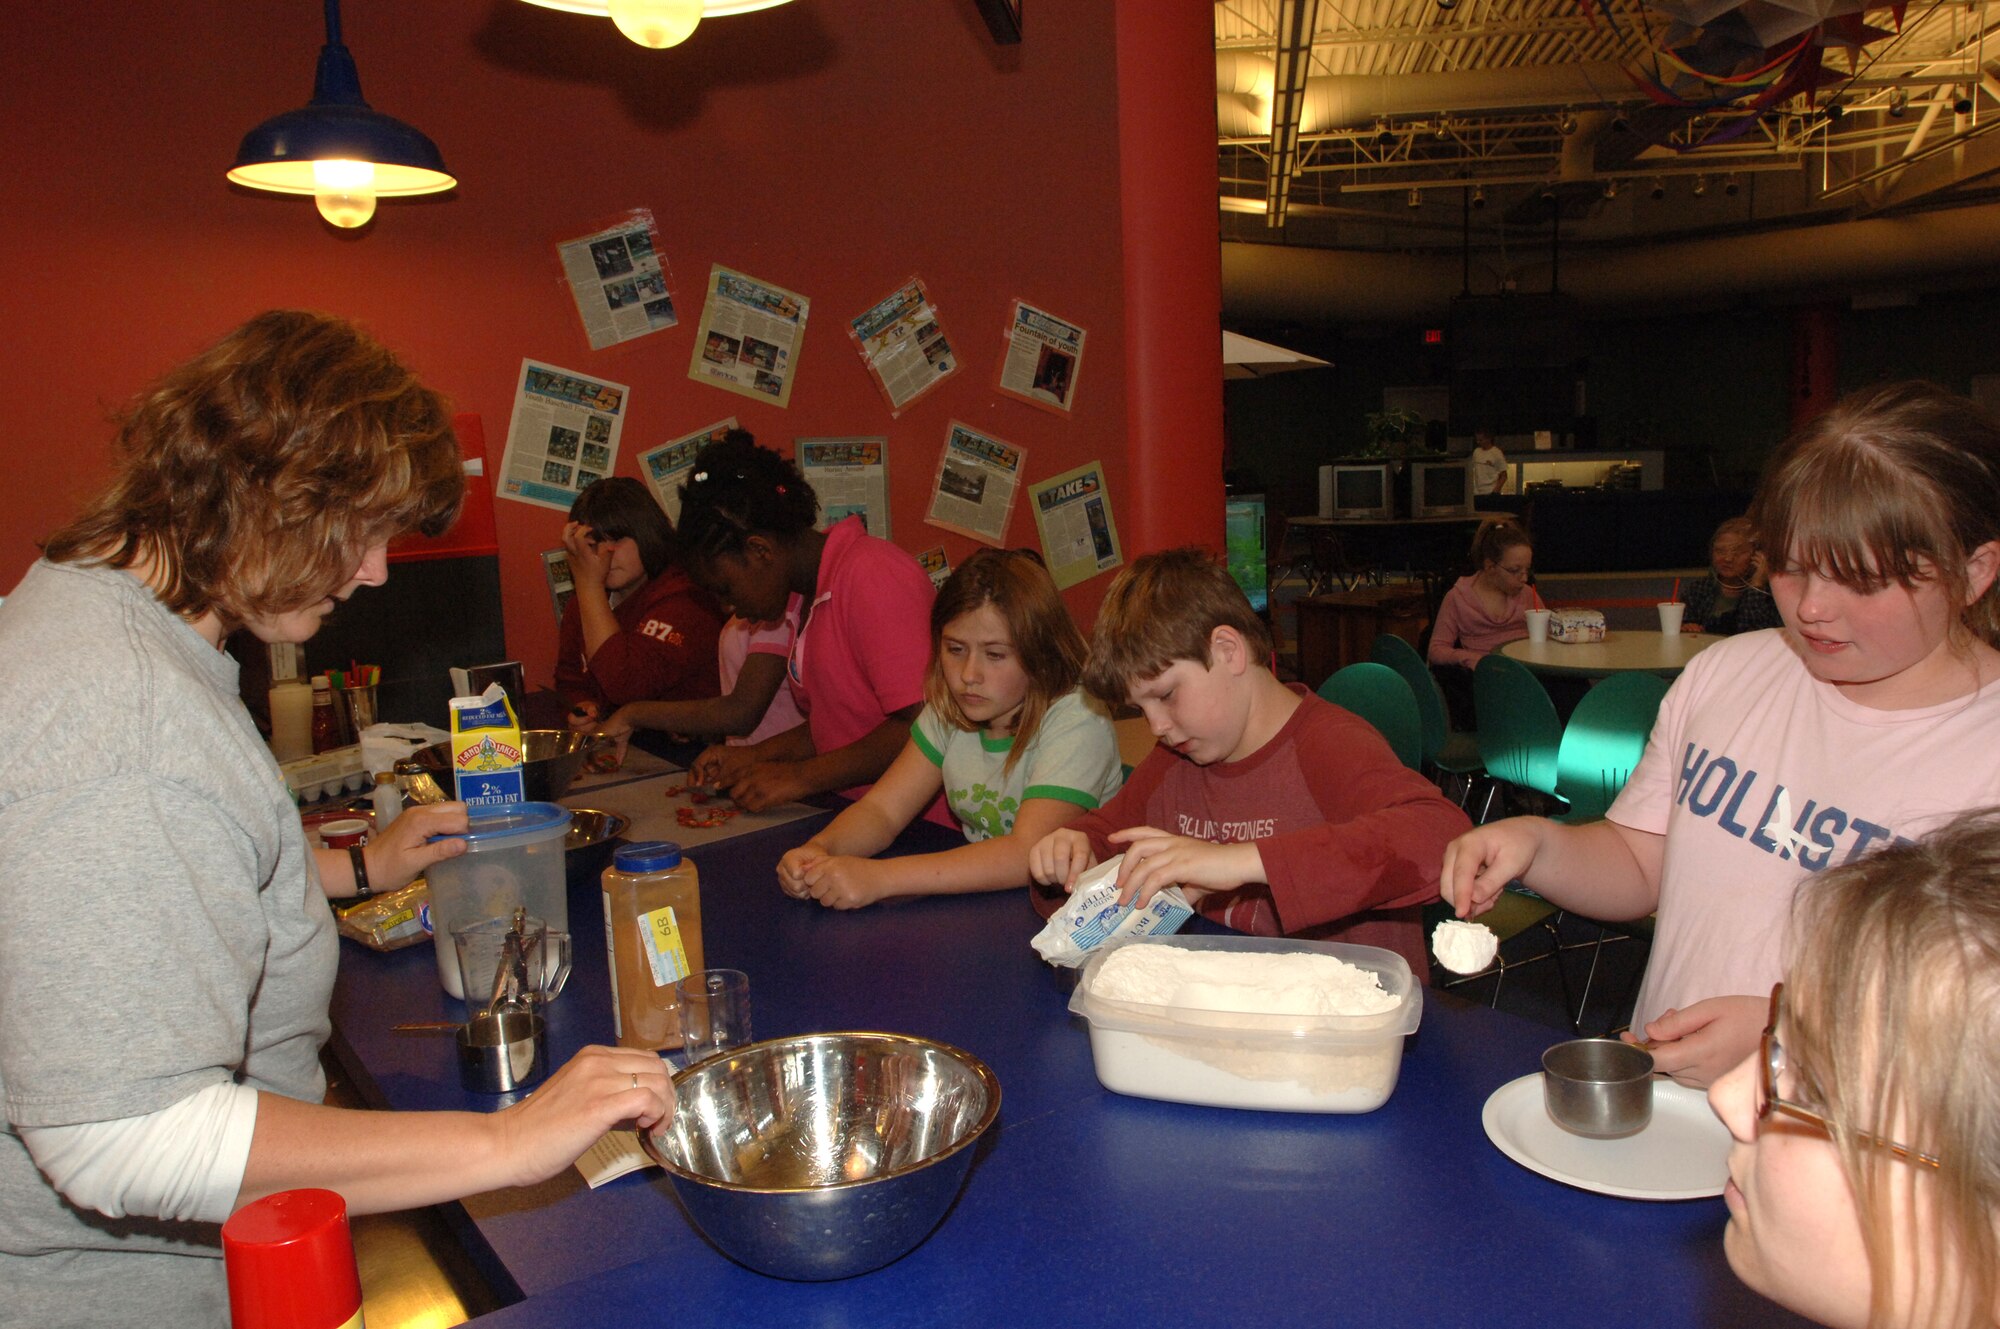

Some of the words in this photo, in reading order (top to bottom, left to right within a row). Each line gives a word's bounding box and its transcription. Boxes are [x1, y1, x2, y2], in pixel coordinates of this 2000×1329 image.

[1014, 322, 1047, 342] Fountain
[1048, 336, 1058, 345] of
[1058, 341, 1079, 354] youth
[1425, 329, 1441, 343] EXIT
[525, 392, 544, 403] Youth
[545, 397, 573, 410] Baseball
[592, 386, 623, 412] 5
[1048, 478, 1084, 504] TAKE
[641, 618, 673, 642] 87
[459, 745, 480, 763] LAND
[496, 743, 519, 758] LAKES
[481, 782, 502, 796] 2%
[465, 794, 504, 807] REDUCED
[504, 793, 519, 803] FAT
[1676, 742, 1920, 872] HOLLIST
[1221, 818, 1274, 841] STONES
[656, 916, 671, 936] 6B
